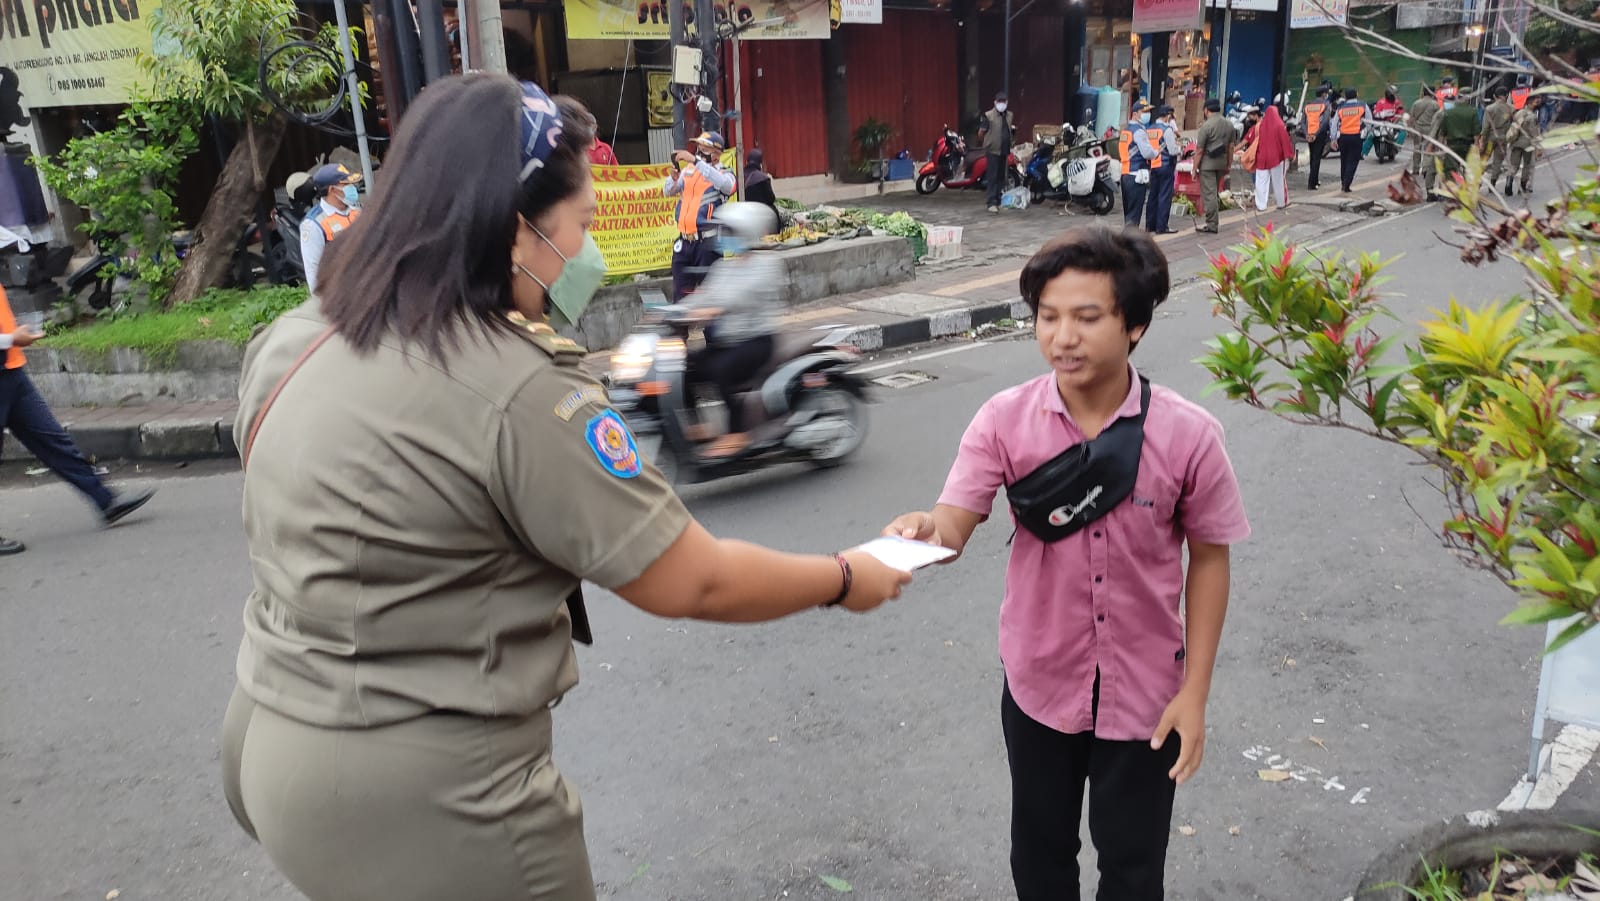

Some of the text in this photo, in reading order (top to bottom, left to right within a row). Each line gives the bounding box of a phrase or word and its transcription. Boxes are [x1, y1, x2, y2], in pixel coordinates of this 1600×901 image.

[70, 78, 86, 91] 1000
[605, 189, 635, 202] LUAR
[646, 214, 675, 228] YANG
